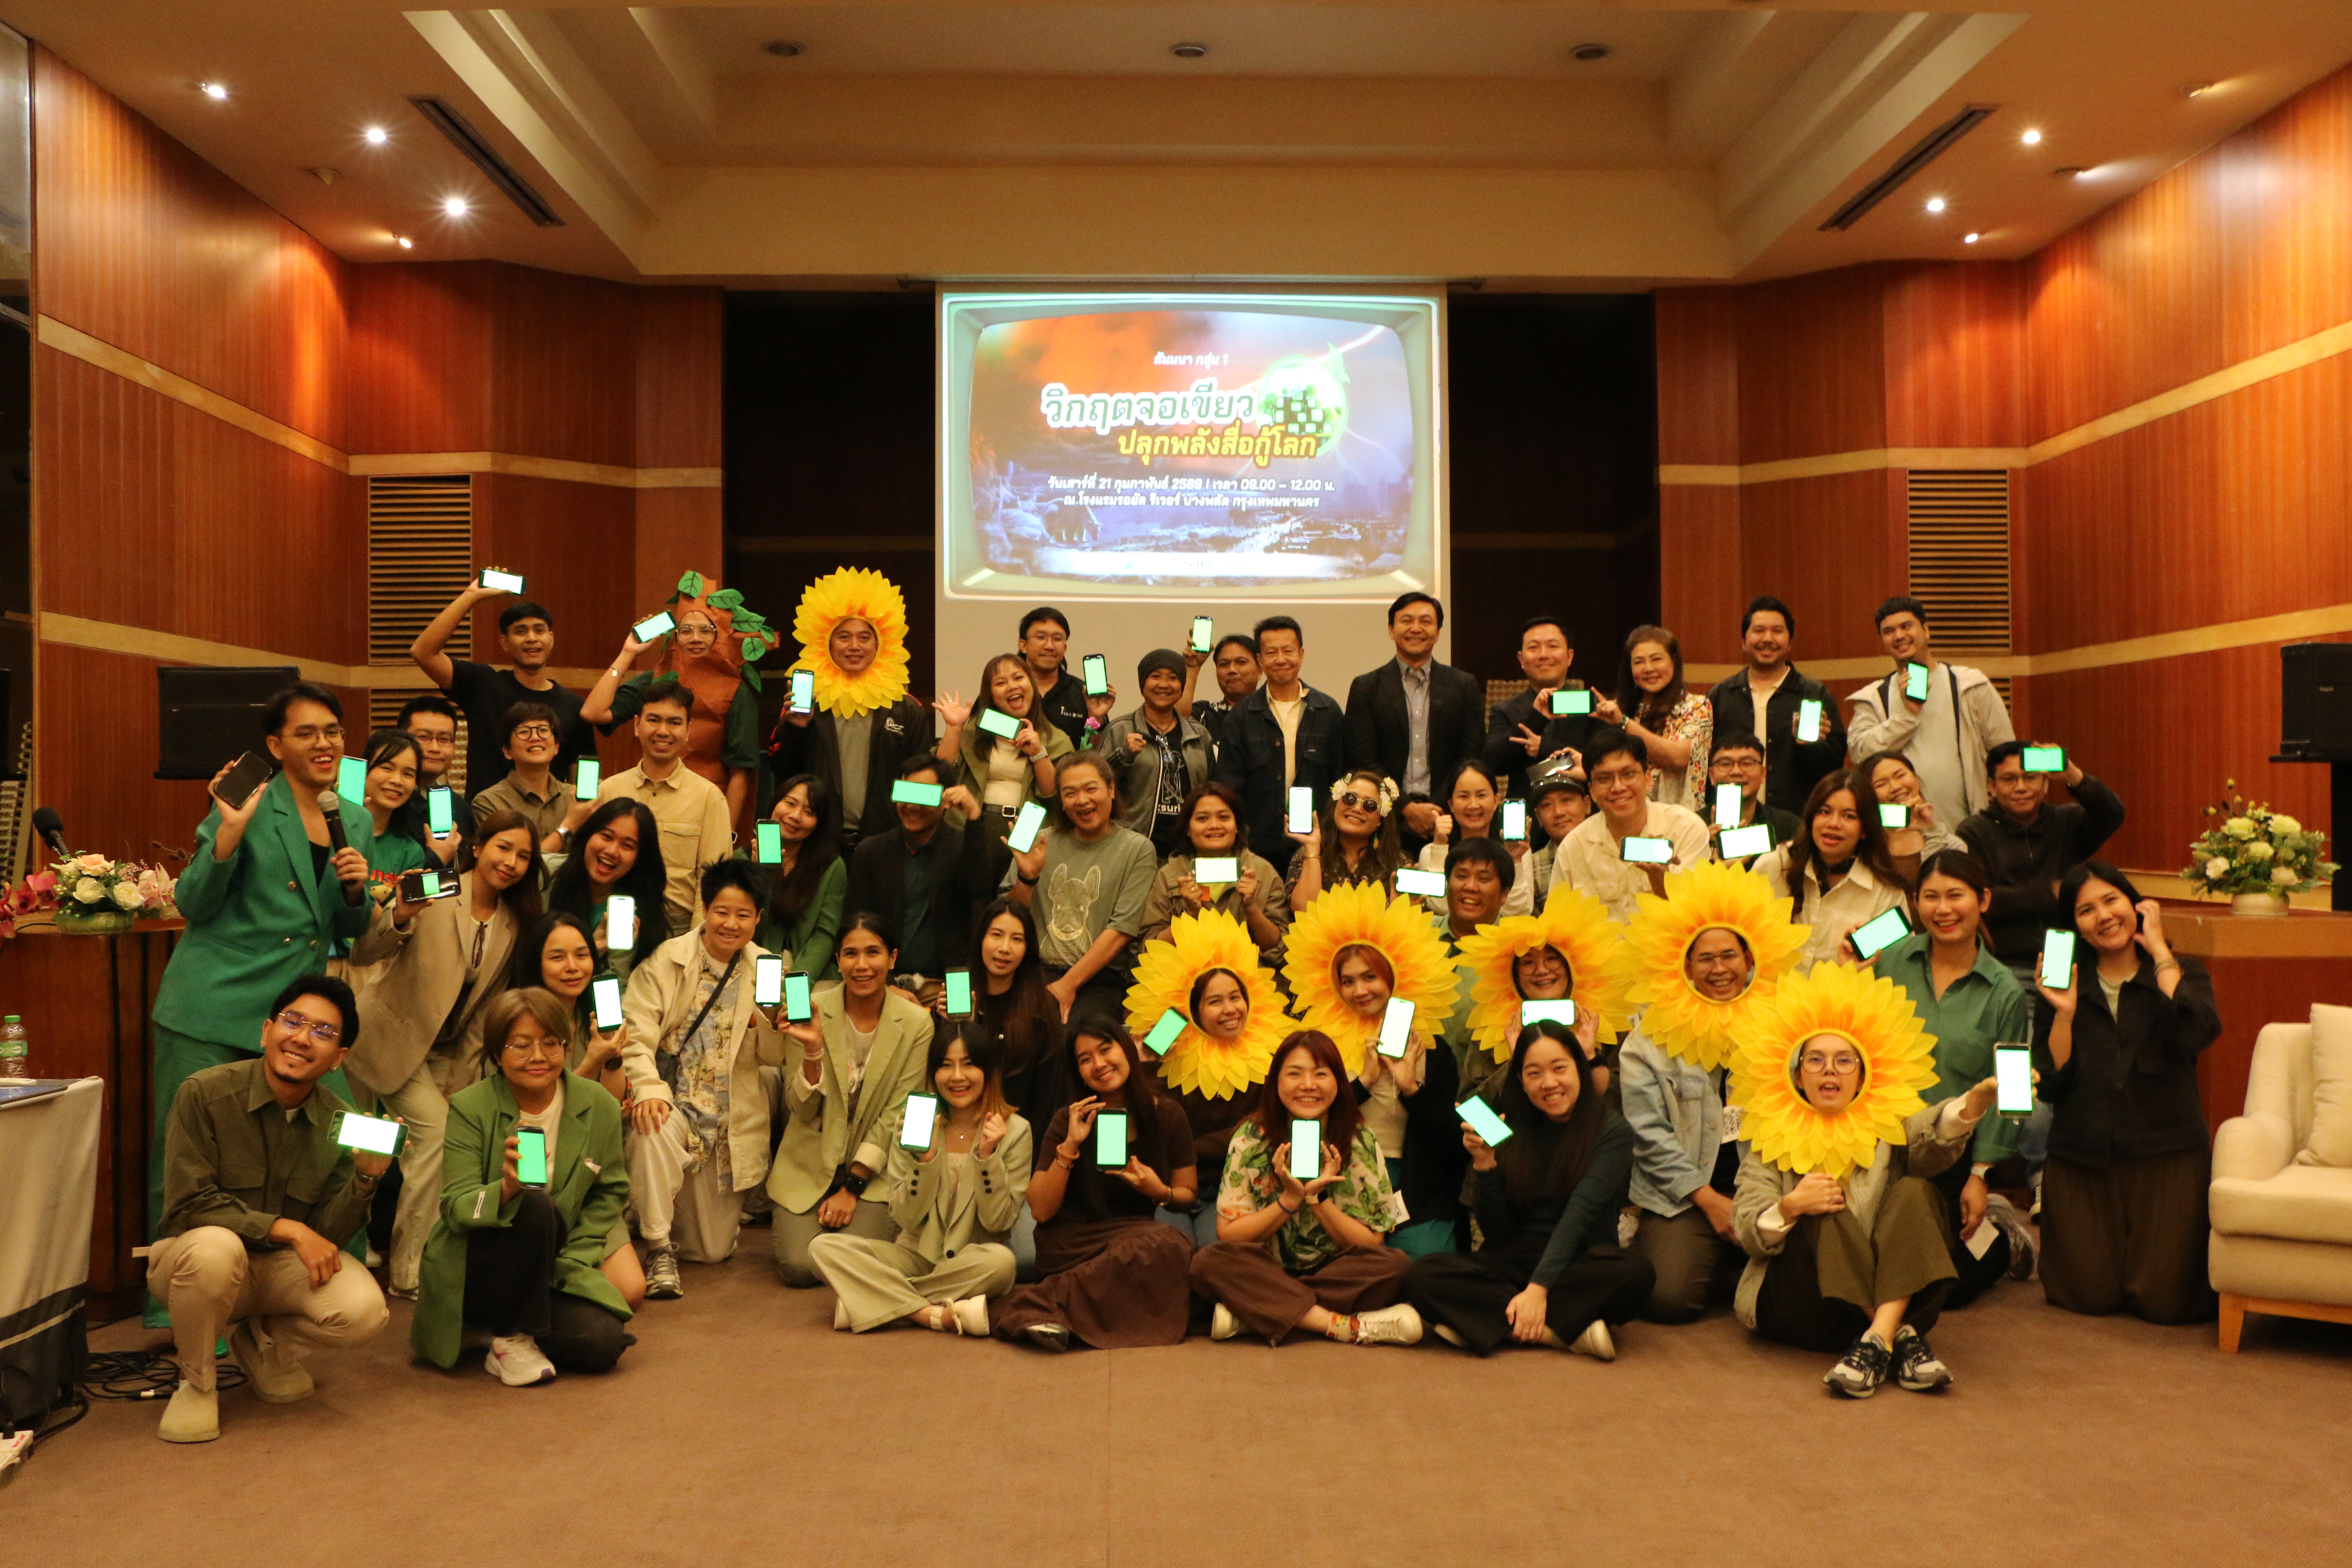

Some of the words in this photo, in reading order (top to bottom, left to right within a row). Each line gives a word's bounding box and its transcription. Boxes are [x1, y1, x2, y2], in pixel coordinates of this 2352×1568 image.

[1154, 351, 1193, 365] สัมมนา
[1196, 352, 1219, 370] กลุ่ม
[1223, 353, 1228, 365] 1
[1042, 380, 1257, 432] วิกฤตจอเขียว
[1118, 420, 1317, 466] ปลุกพลังสื่อกู้โลก
[1047, 472, 1097, 489] วันเสาร์ที่
[1098, 478, 1112, 489] 21
[1114, 475, 1170, 494] กุมภาพันธ์
[1171, 478, 1203, 490] 2569
[1212, 480, 1238, 490] เวลา
[1240, 478, 1276, 490] 09.00
[1290, 479, 1321, 491] 12.00
[1324, 480, 1335, 491] น.
[1183, 493, 1229, 507] บางพลัด
[1232, 497, 1320, 512] กรุงเทพมหานคร
